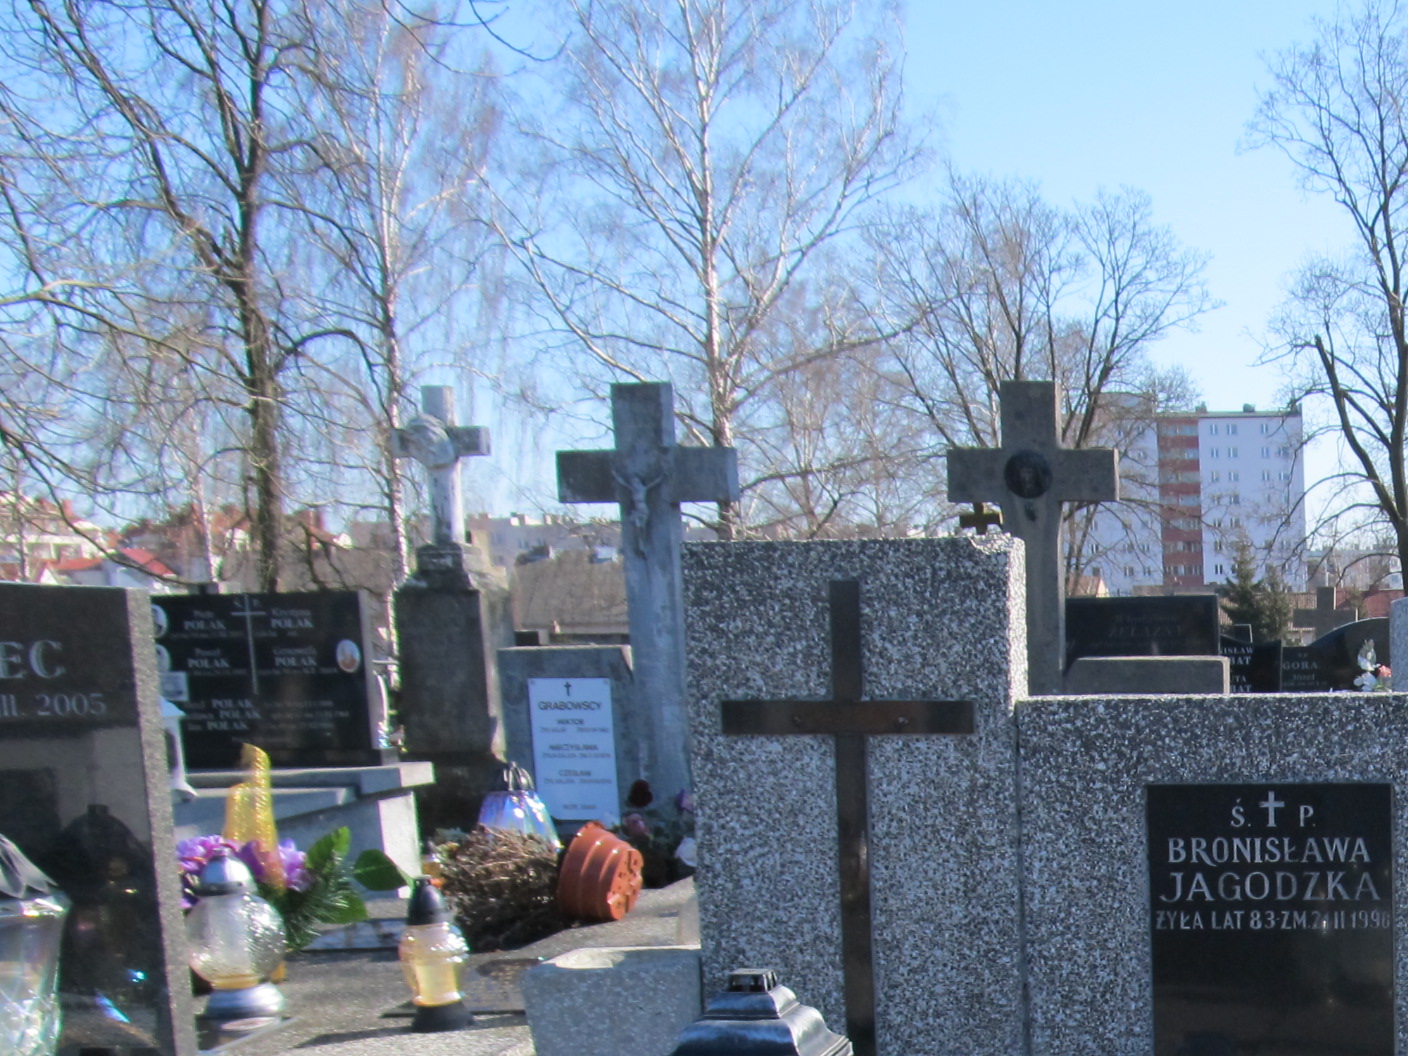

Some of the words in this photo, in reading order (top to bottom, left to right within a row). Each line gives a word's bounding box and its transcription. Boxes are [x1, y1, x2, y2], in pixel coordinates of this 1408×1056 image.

[183, 620, 227, 630] POLAK
[270, 618, 314, 629] POLAK
[187, 658, 230, 668] POLAK
[275, 656, 317, 666] POLAK
[35, 692, 107, 717] 2005
[538, 701, 601, 710] GRABOWSCY
[1230, 797, 1251, 828] Ś.
[1300, 805, 1316, 828] P.
[1168, 837, 1371, 867] BRONISŁAWA
[1159, 871, 1381, 902] JAGODZKA
[1155, 910, 1204, 931] ŻYŁA
[1211, 910, 1245, 930] LAT
